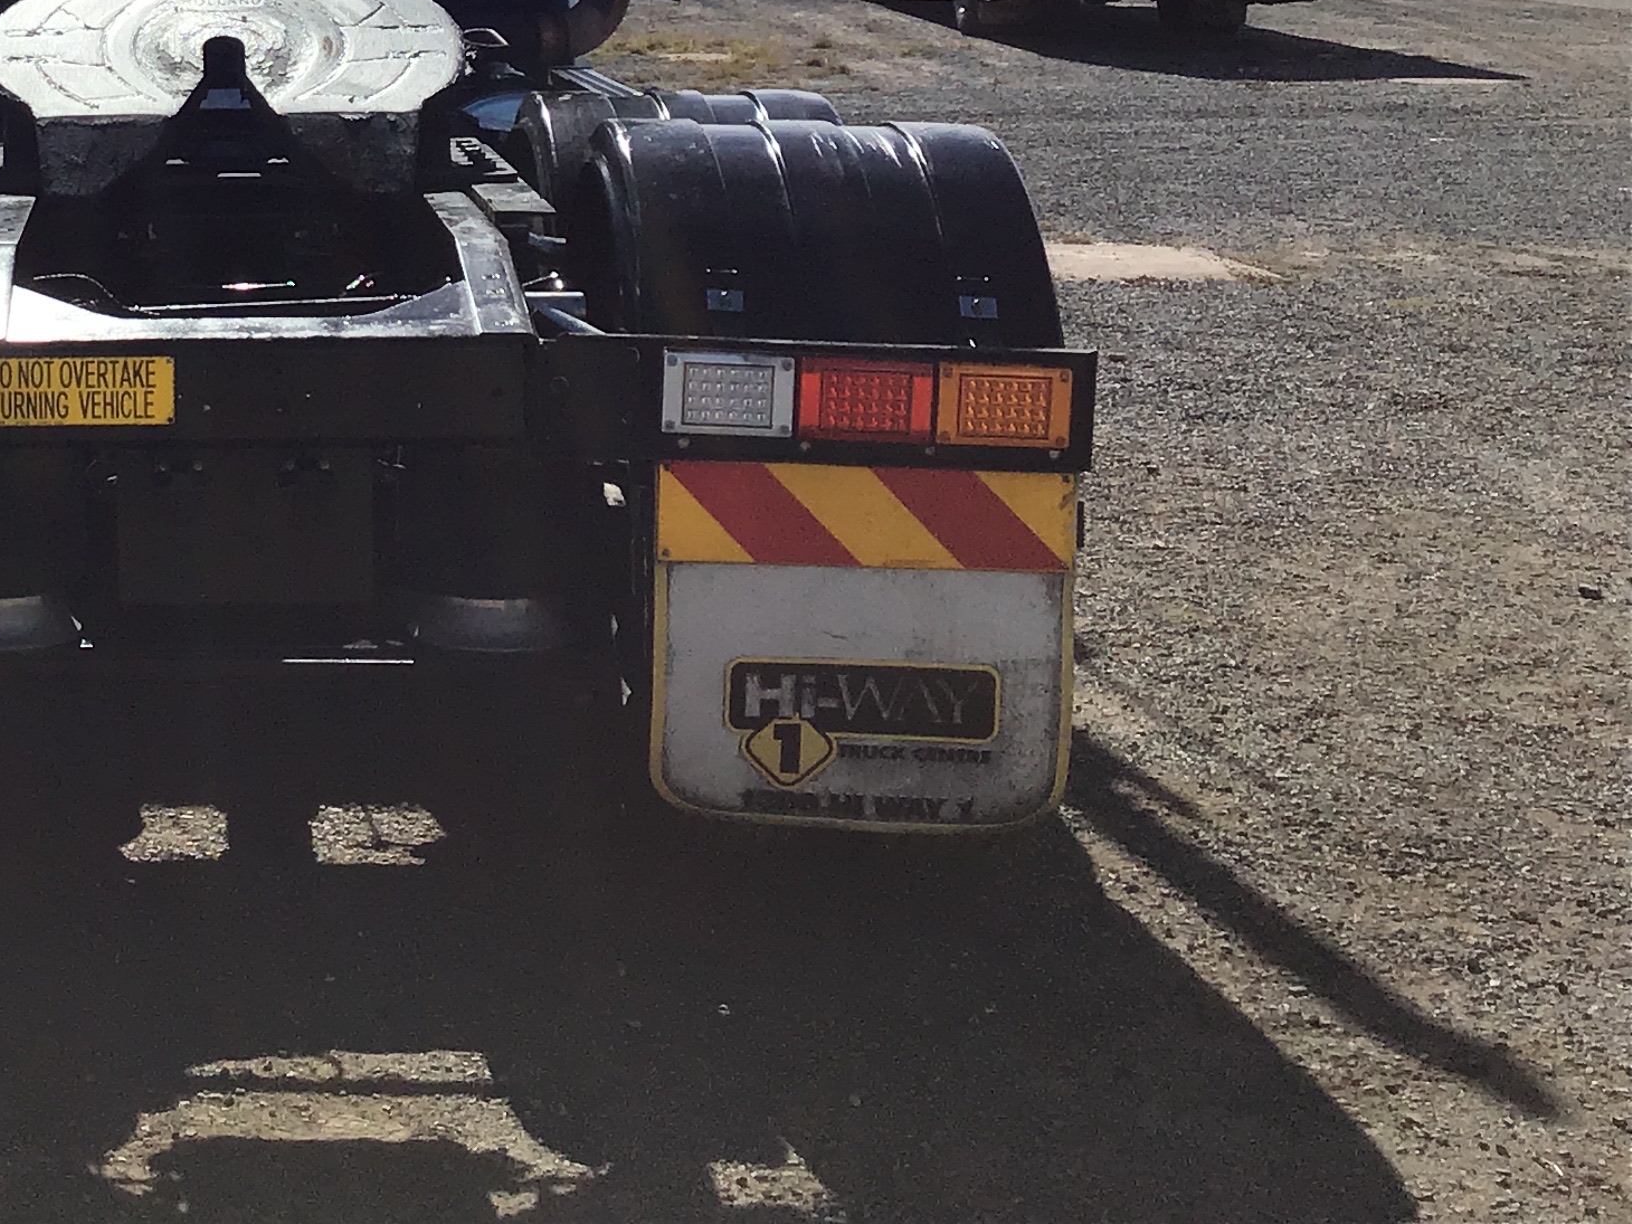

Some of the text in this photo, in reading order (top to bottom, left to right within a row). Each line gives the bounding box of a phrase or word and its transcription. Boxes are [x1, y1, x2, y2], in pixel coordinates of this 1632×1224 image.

[18, 360, 55, 389] NOT
[59, 359, 157, 389] OVERTAKE
[78, 390, 156, 419] VEHICLE
[773, 723, 802, 774] 1
[838, 743, 906, 760] TRUCK
